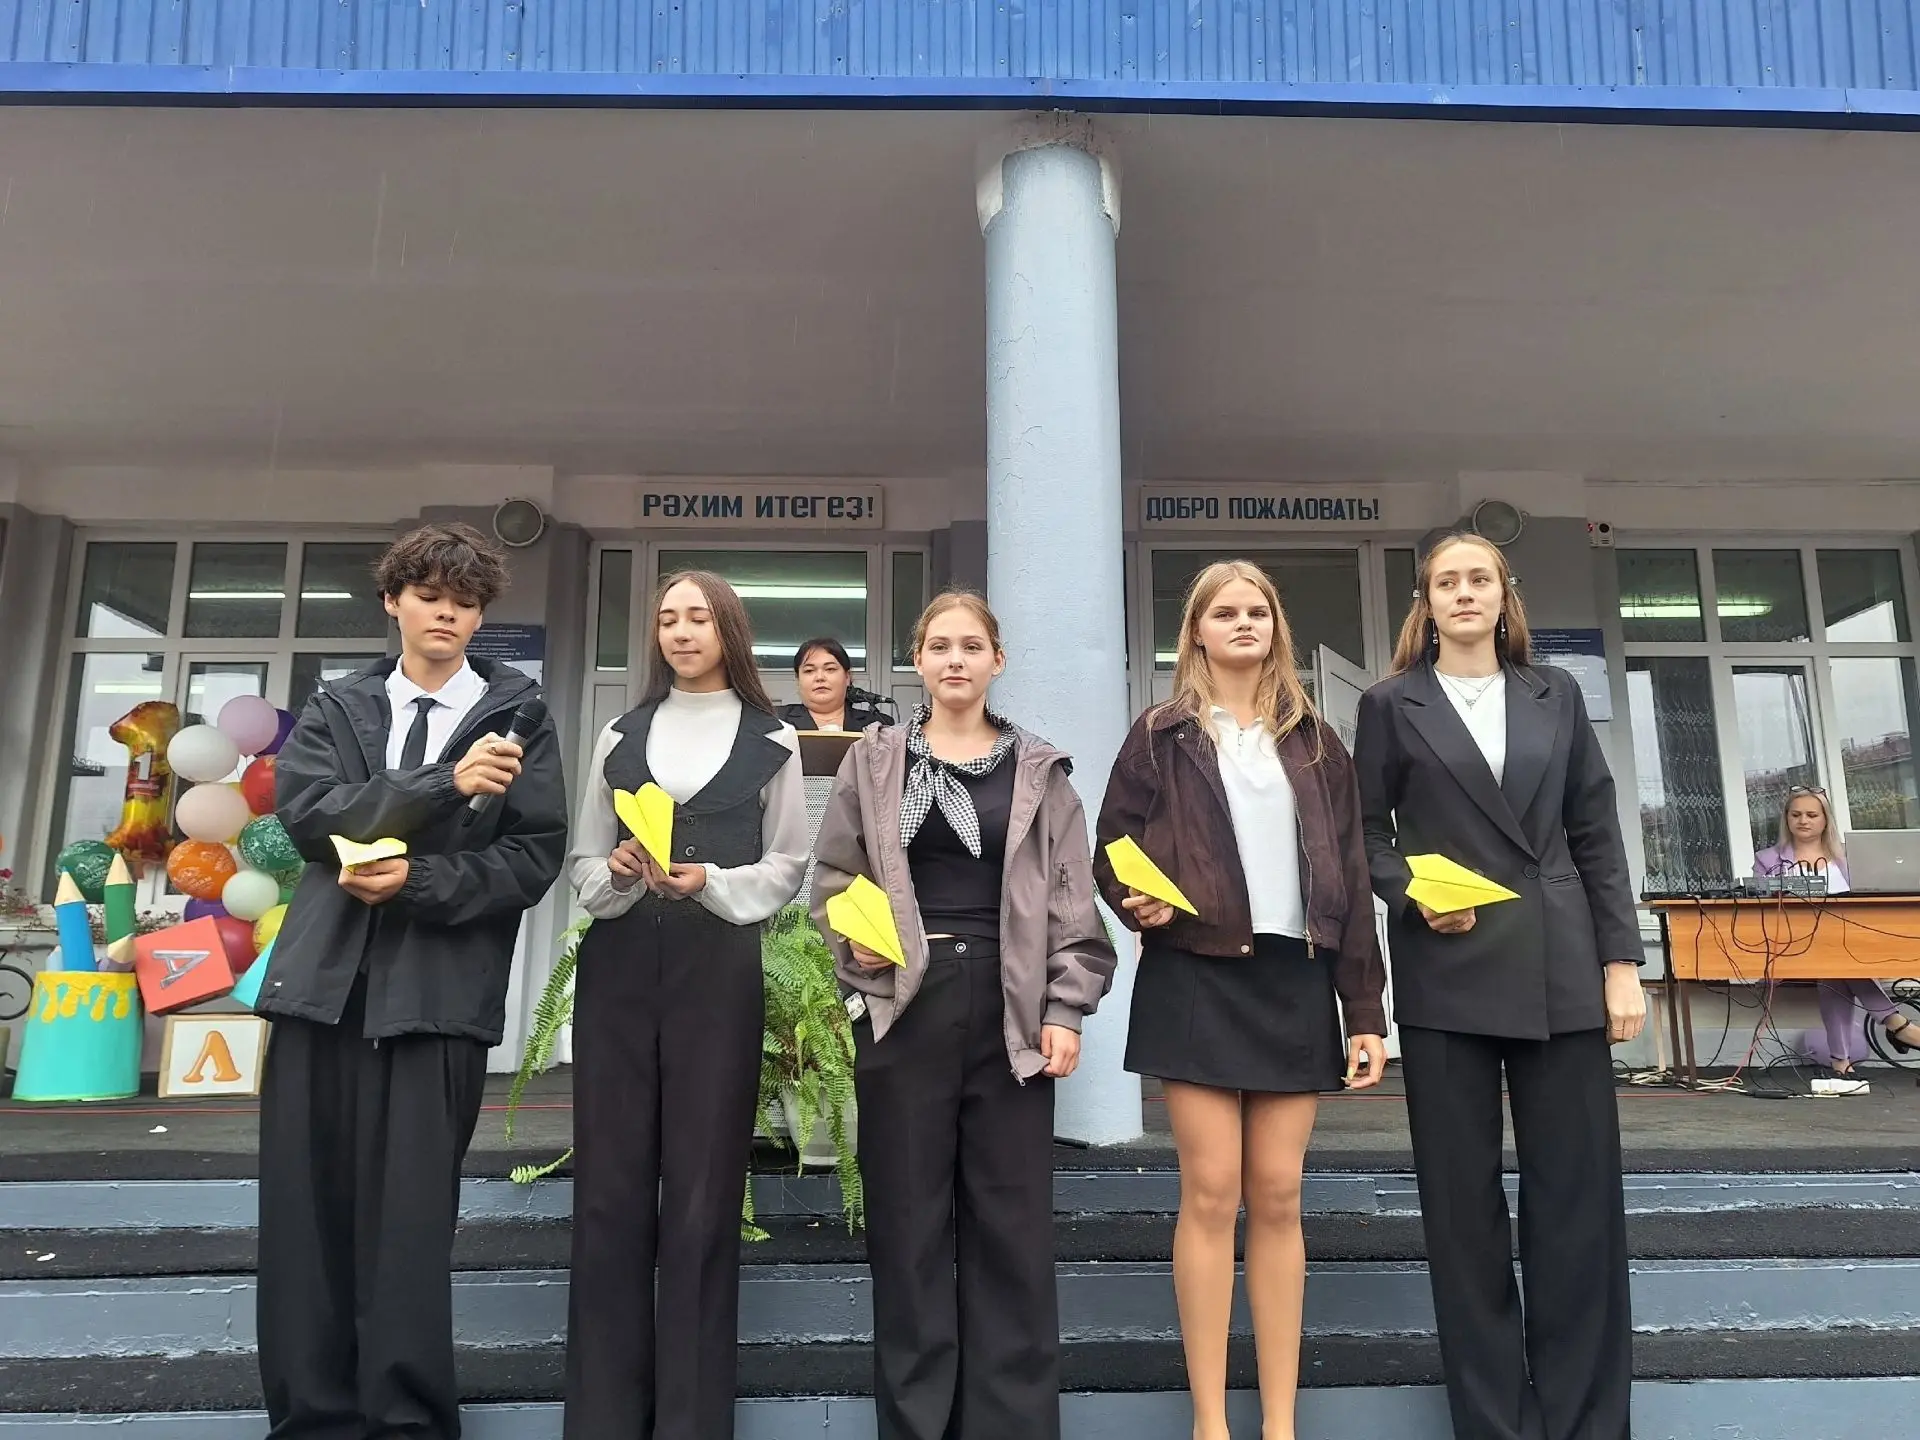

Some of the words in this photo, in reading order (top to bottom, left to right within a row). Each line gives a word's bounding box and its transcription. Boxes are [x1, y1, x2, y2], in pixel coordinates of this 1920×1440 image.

[1146, 497, 1219, 521] ДОБРО
[1229, 497, 1379, 520] ПОЖАЛОВАТЬ!
[134, 751, 152, 780] 1
